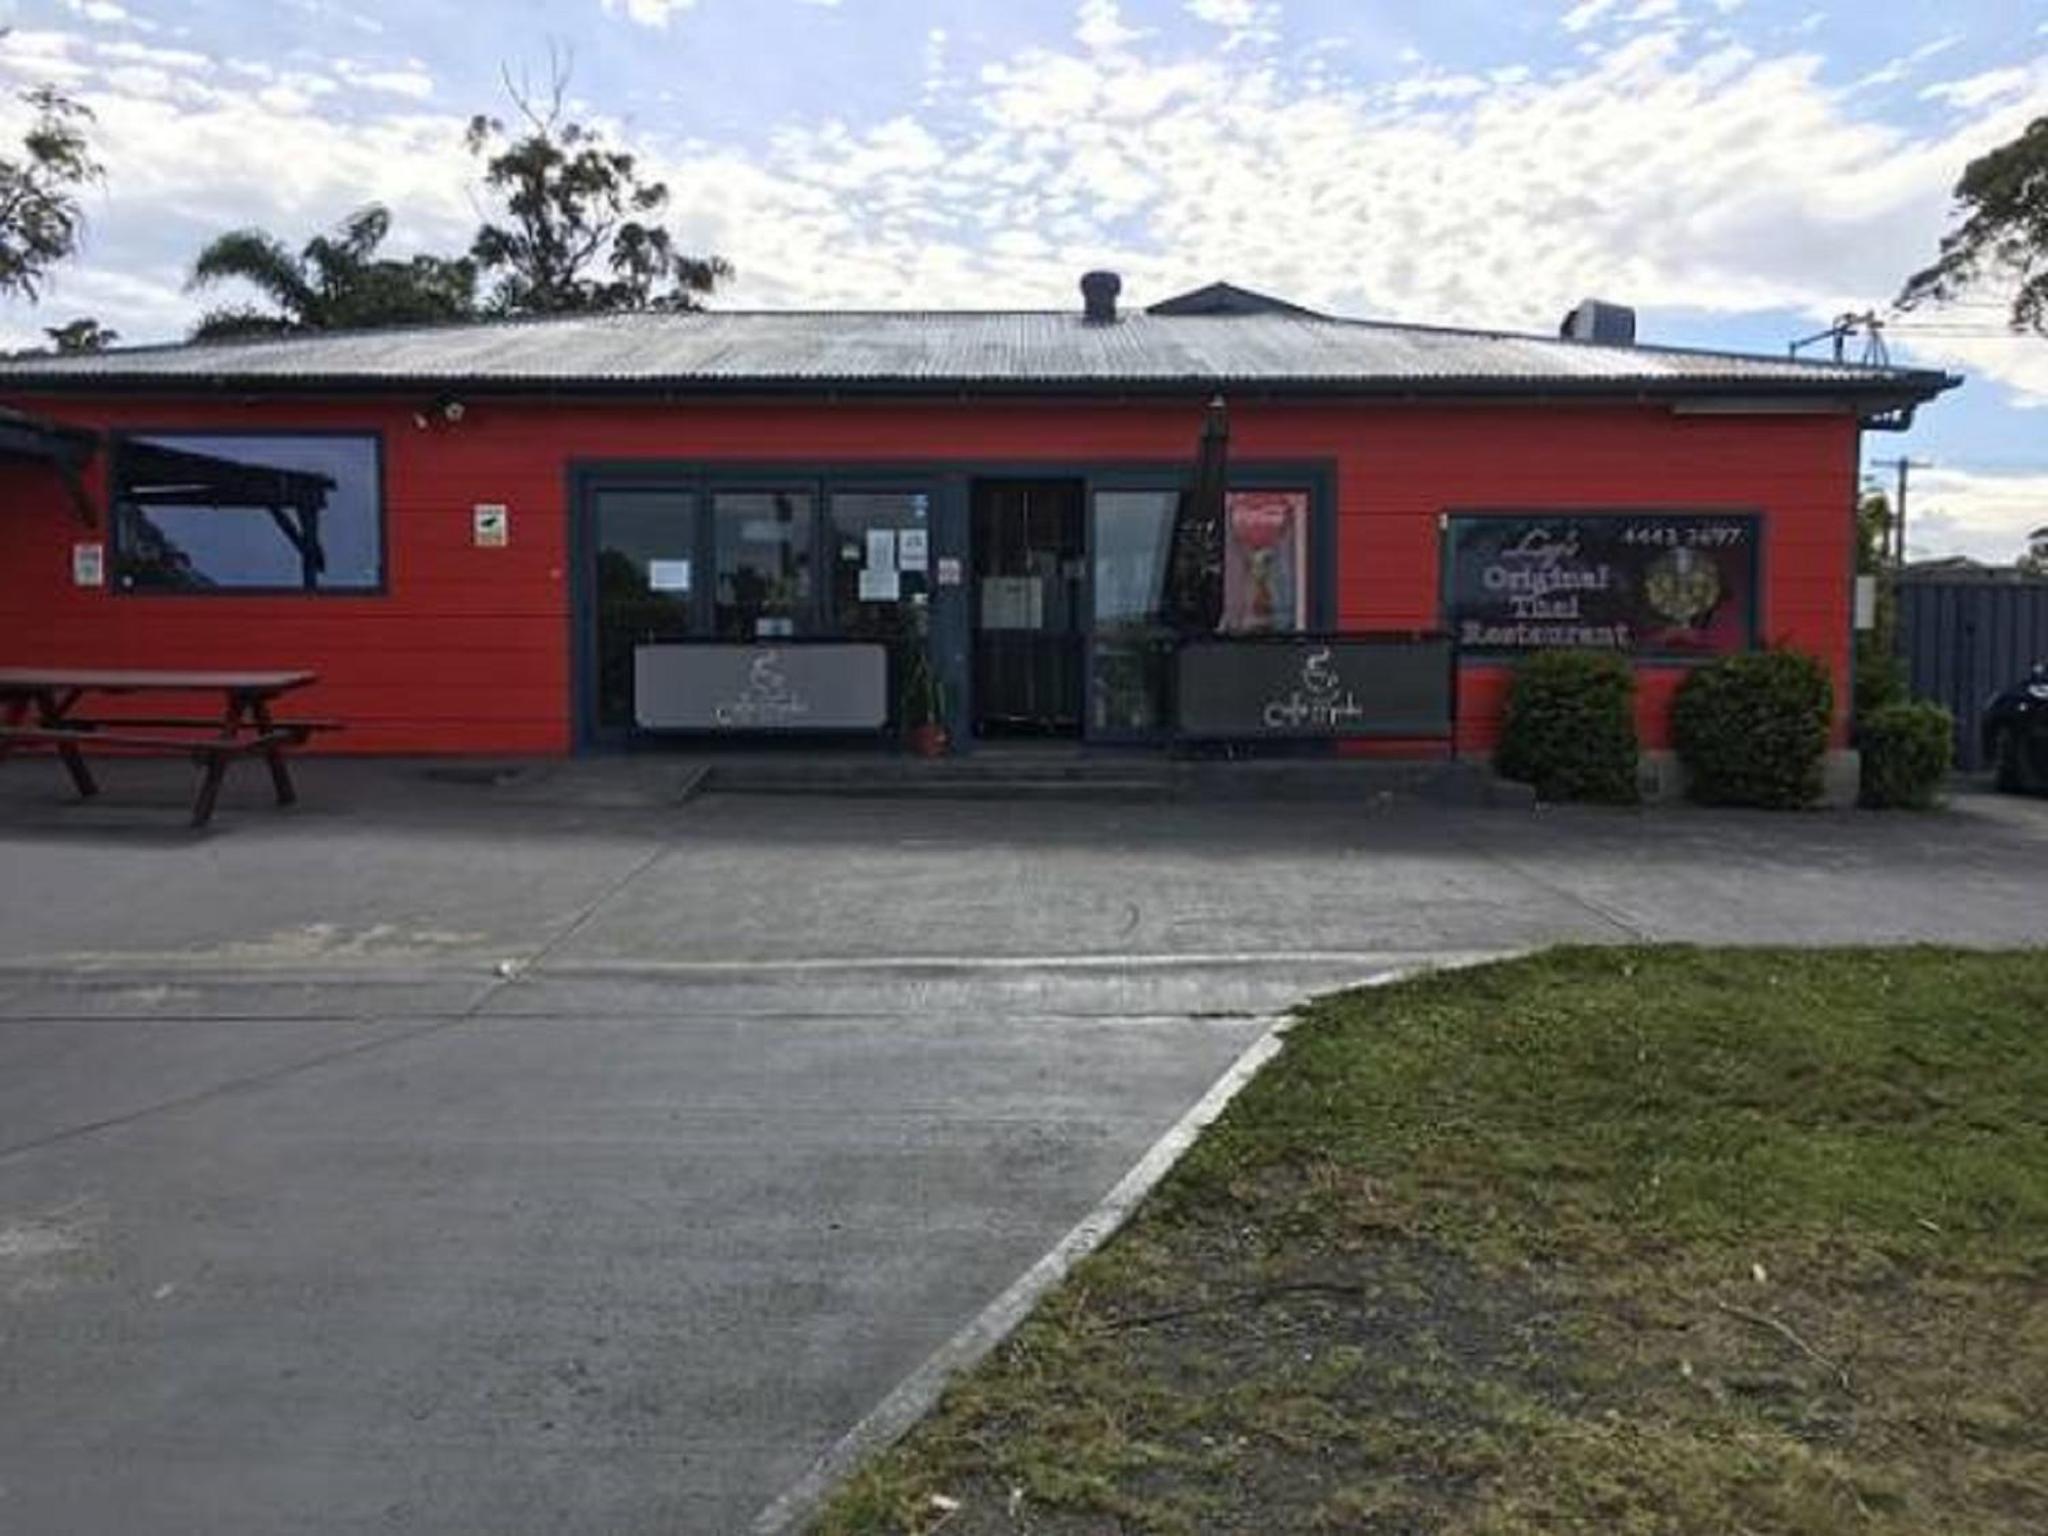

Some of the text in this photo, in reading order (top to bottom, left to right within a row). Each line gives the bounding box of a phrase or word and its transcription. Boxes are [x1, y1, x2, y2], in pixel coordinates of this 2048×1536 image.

[1482, 563, 1611, 597] Original
[1509, 594, 1580, 619] Thai
[1459, 620, 1629, 646] Restaurant
